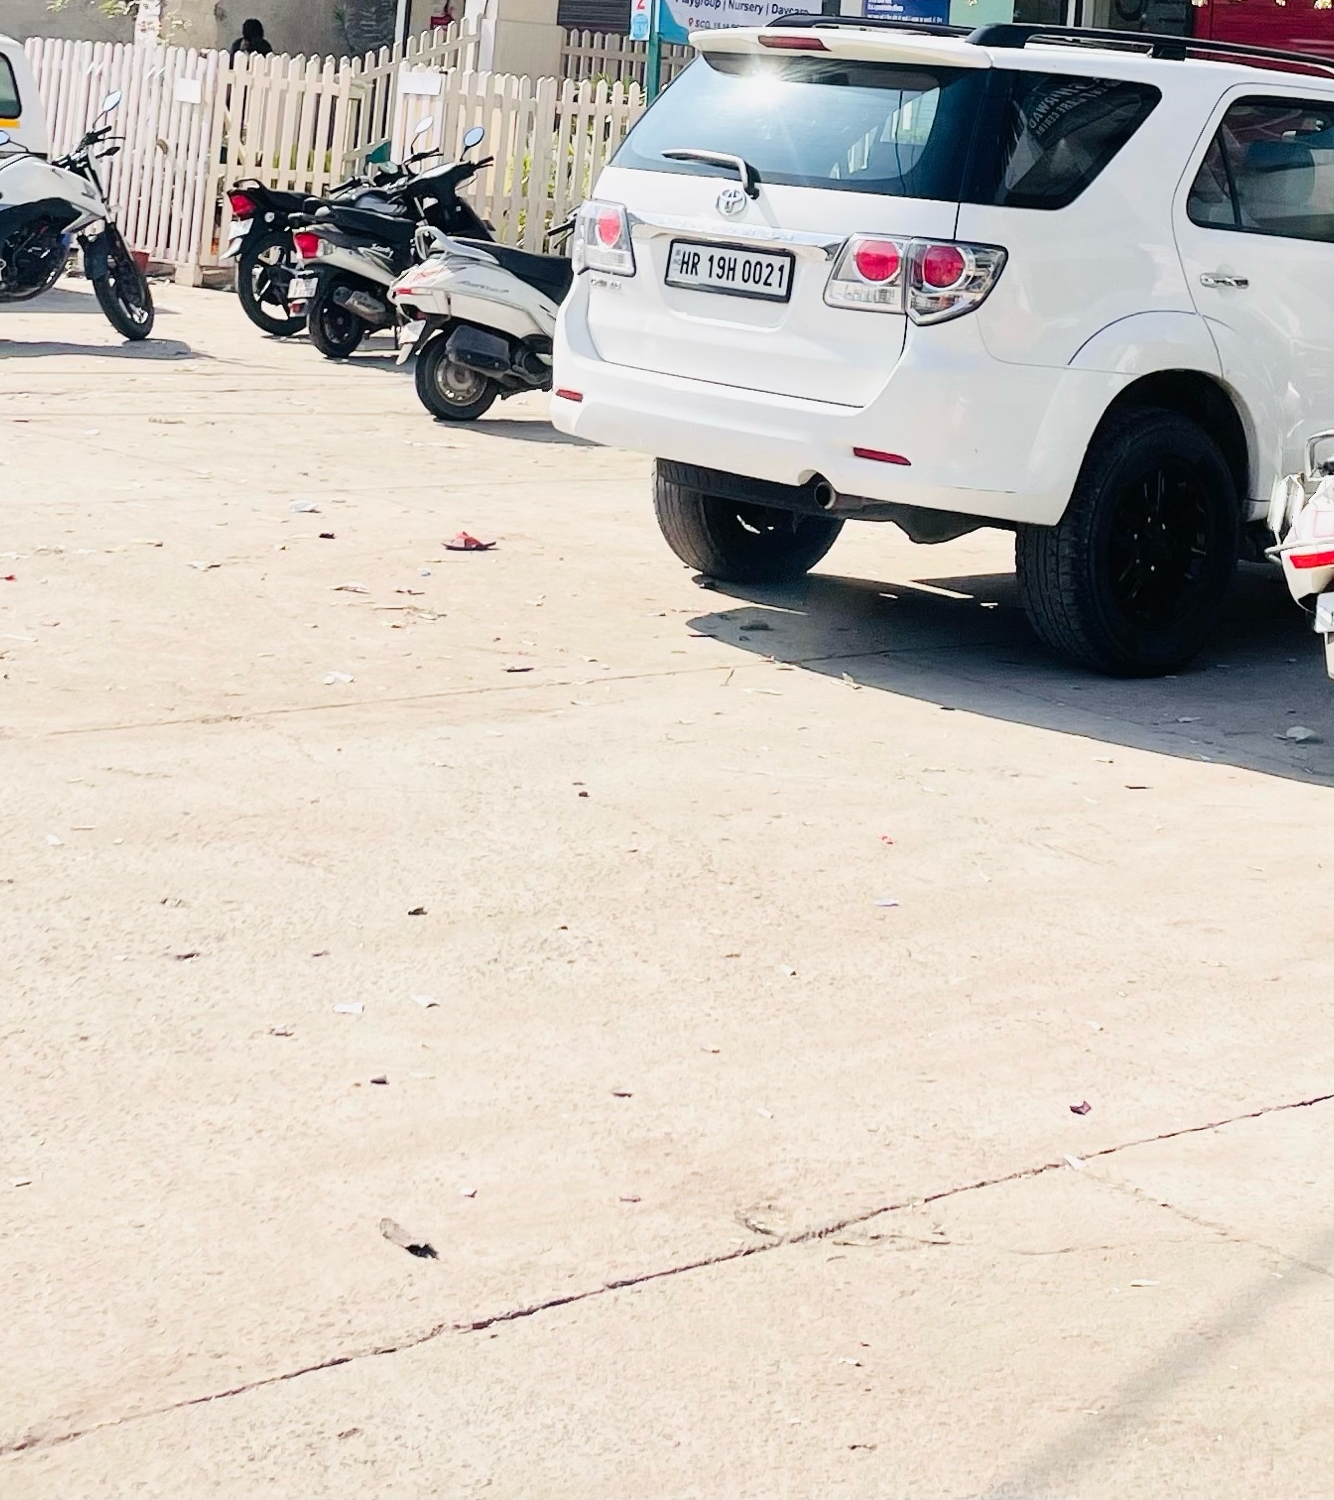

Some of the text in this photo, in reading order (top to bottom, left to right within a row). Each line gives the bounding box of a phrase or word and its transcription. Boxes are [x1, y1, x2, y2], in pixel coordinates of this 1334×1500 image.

[728, 0, 764, 16] Nursery
[680, 251, 786, 290] HR 19H 0021
